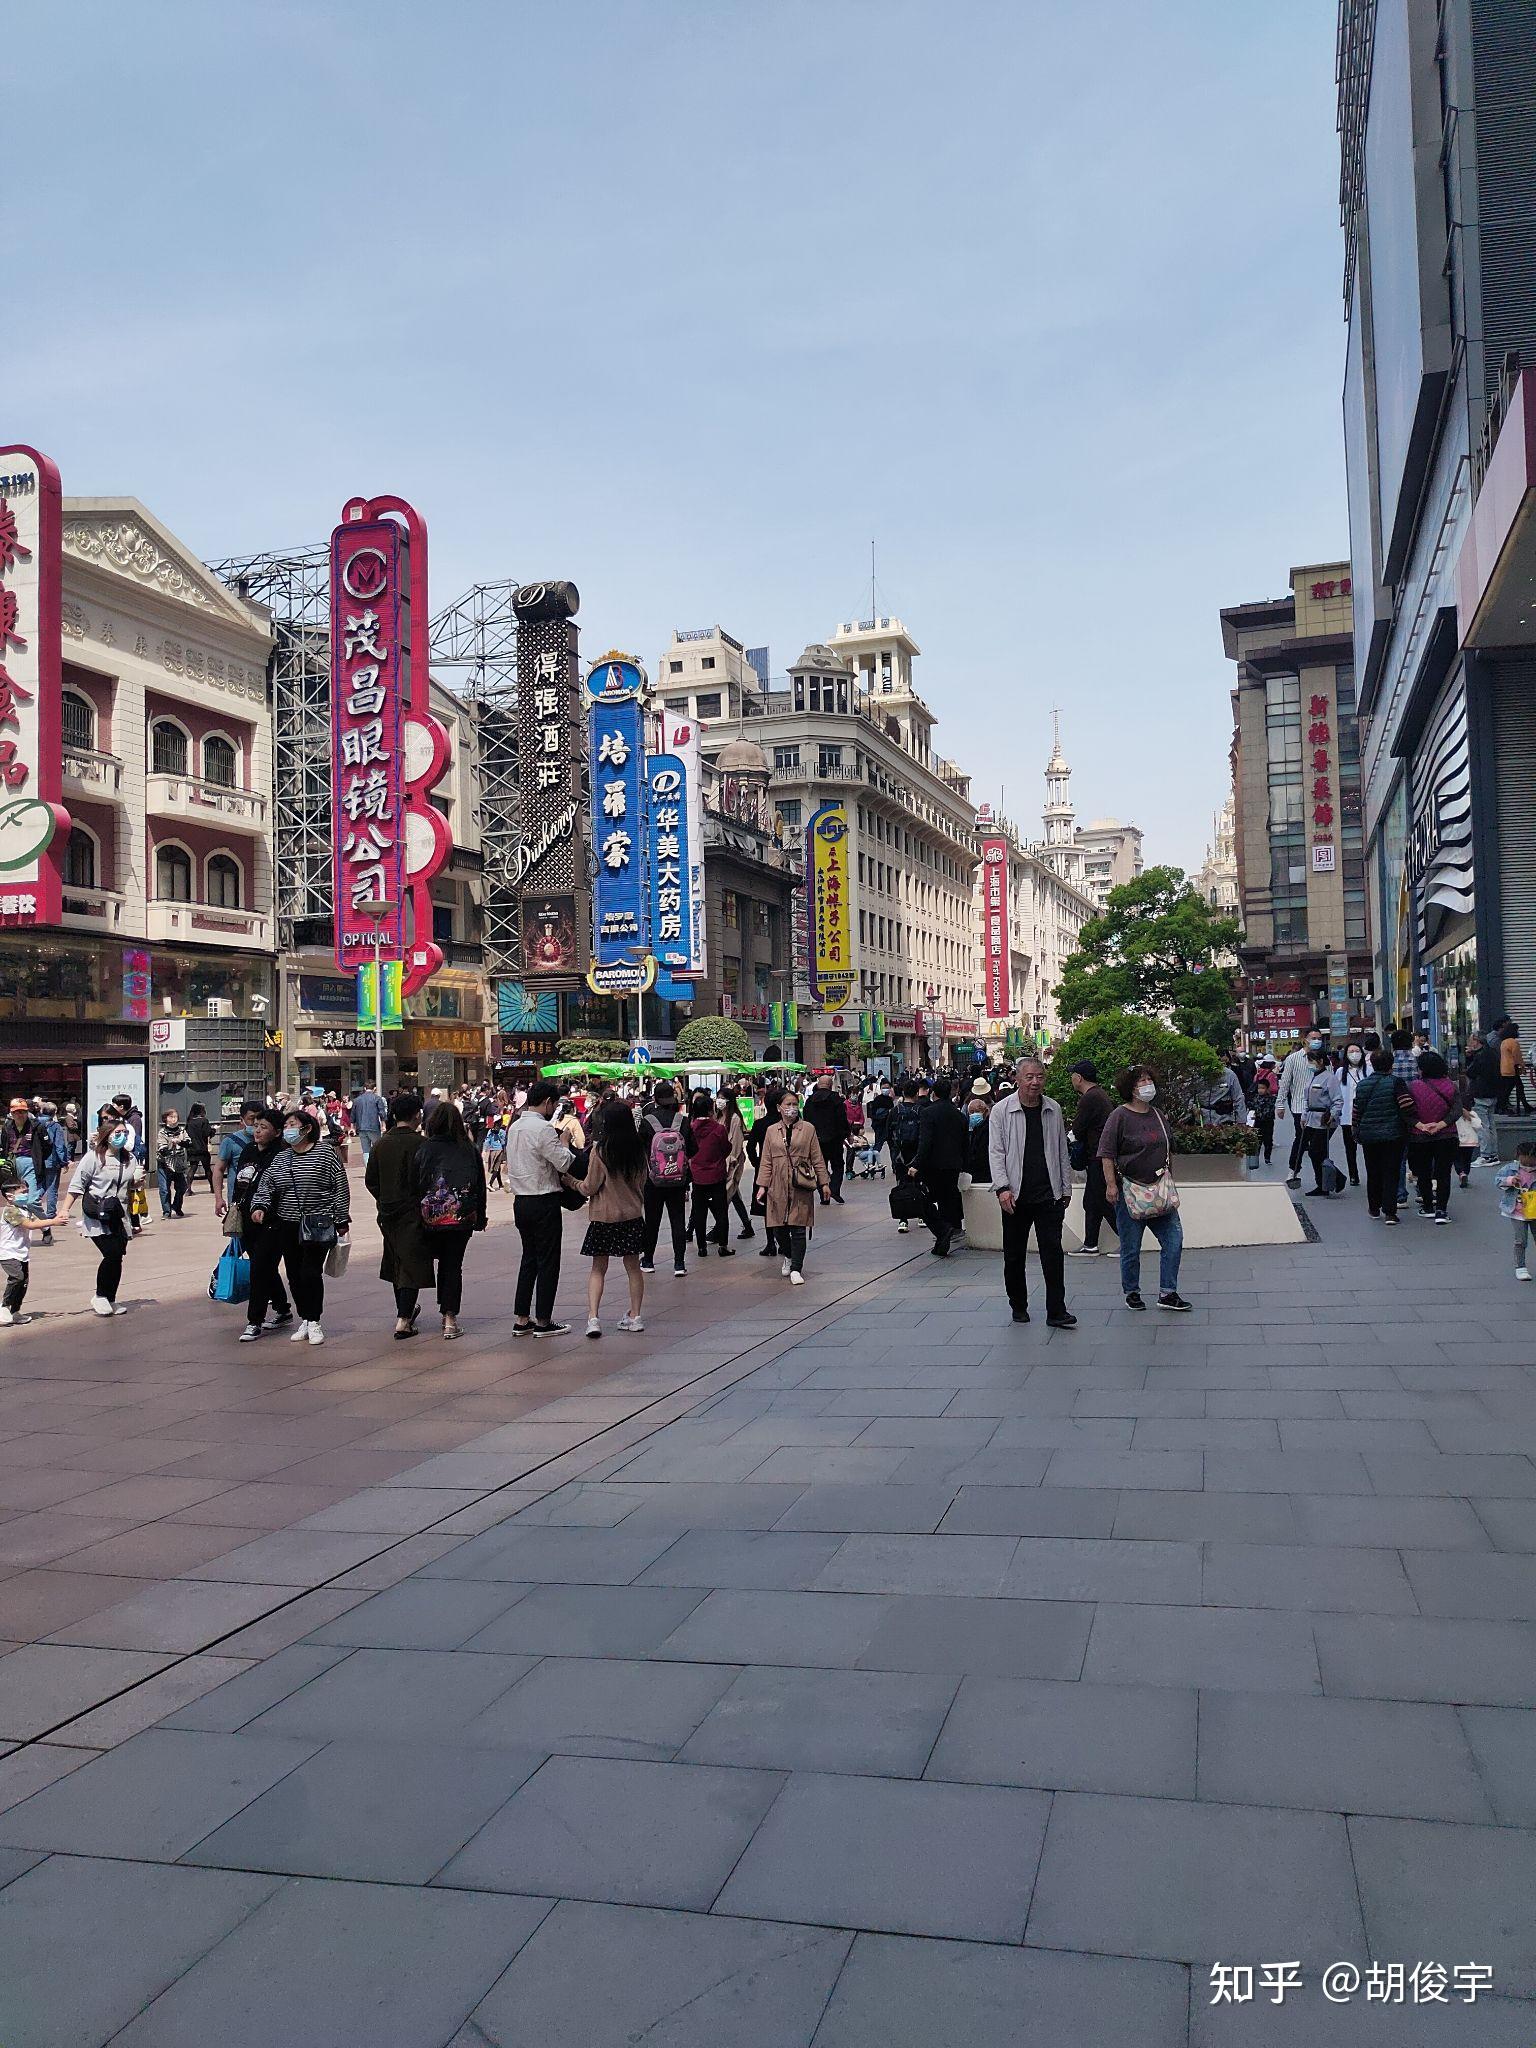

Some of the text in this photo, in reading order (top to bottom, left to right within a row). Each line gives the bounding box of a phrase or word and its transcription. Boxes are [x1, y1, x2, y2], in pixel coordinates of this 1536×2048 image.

[342, 608, 393, 910] 茂昌眼镜公司
[504, 800, 579, 886] Duchamp
[656, 807, 682, 939] 华美大药房
